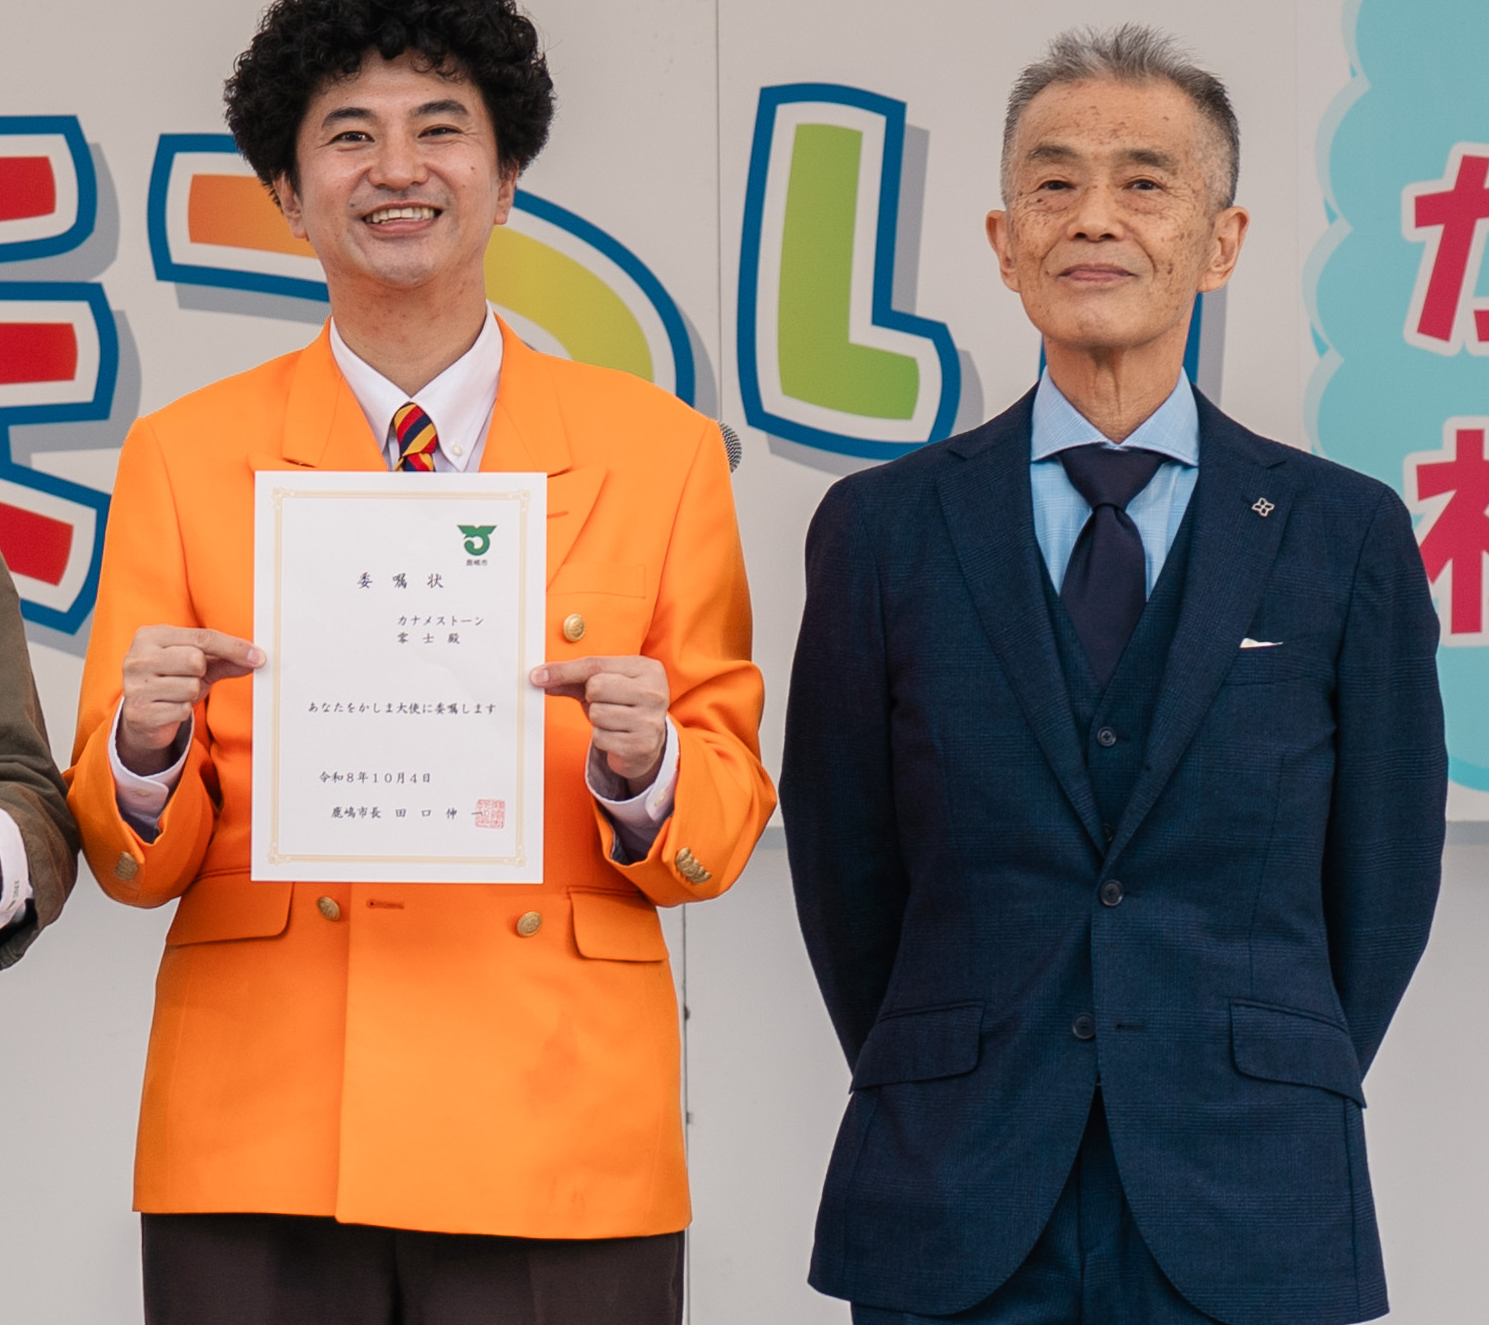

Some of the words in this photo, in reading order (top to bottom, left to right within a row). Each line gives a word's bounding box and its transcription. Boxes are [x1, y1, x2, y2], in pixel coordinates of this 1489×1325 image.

[397, 615, 484, 626] カナメストーン
